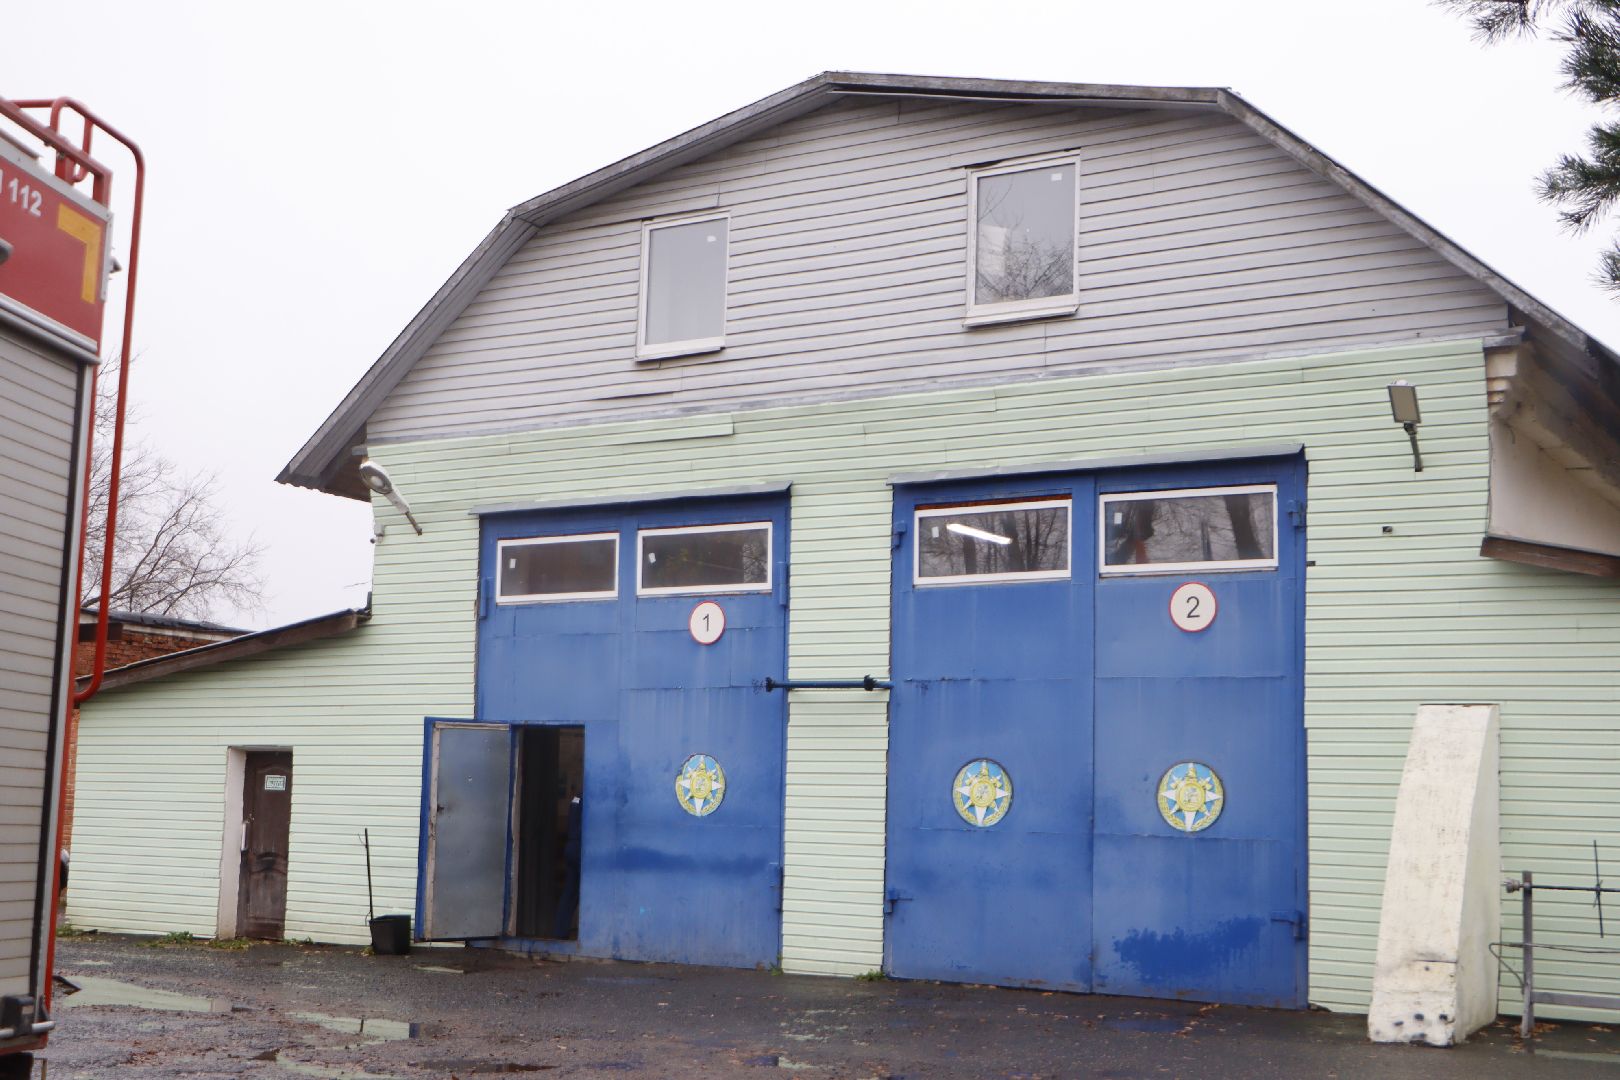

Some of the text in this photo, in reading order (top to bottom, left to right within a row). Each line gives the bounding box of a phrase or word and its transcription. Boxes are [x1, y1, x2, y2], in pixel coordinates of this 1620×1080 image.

[9, 178, 42, 217] 112
[1186, 596, 1200, 618] 2
[702, 613, 710, 632] 1
